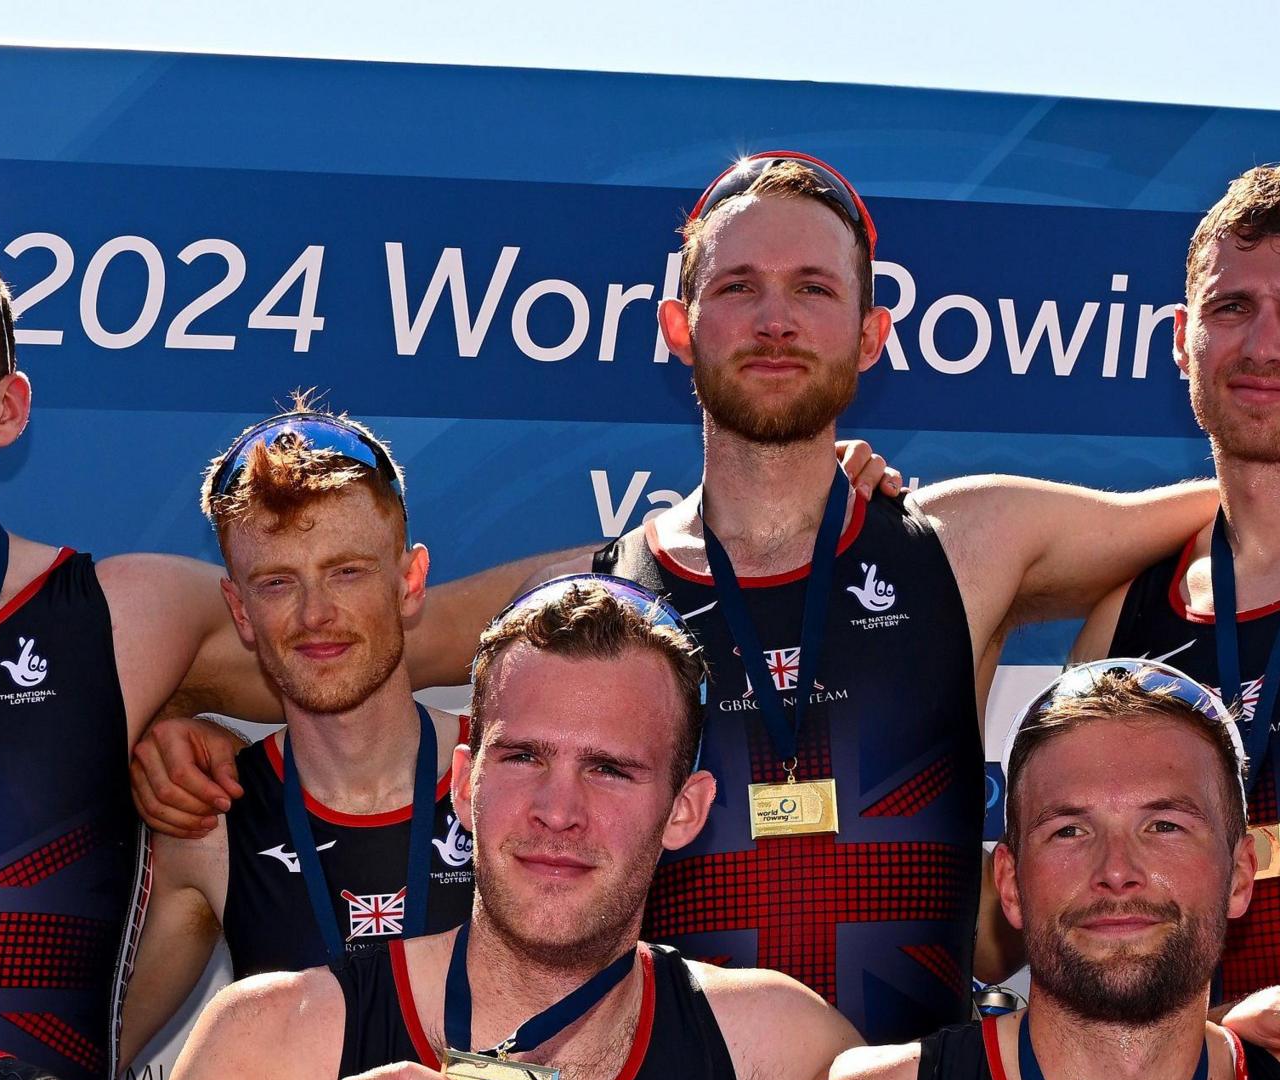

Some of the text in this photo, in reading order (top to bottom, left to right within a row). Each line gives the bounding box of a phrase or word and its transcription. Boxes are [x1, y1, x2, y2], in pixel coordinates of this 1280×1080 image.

[3, 231, 325, 353] 2024
[385, 241, 683, 363] Worl
[872, 261, 1187, 379] Rowin
[850, 613, 910, 627] THE NATIONAL
[863, 620, 900, 630] LOTTERY
[16, 689, 57, 699] NATIONAL
[10, 696, 46, 705] LOTTERY
